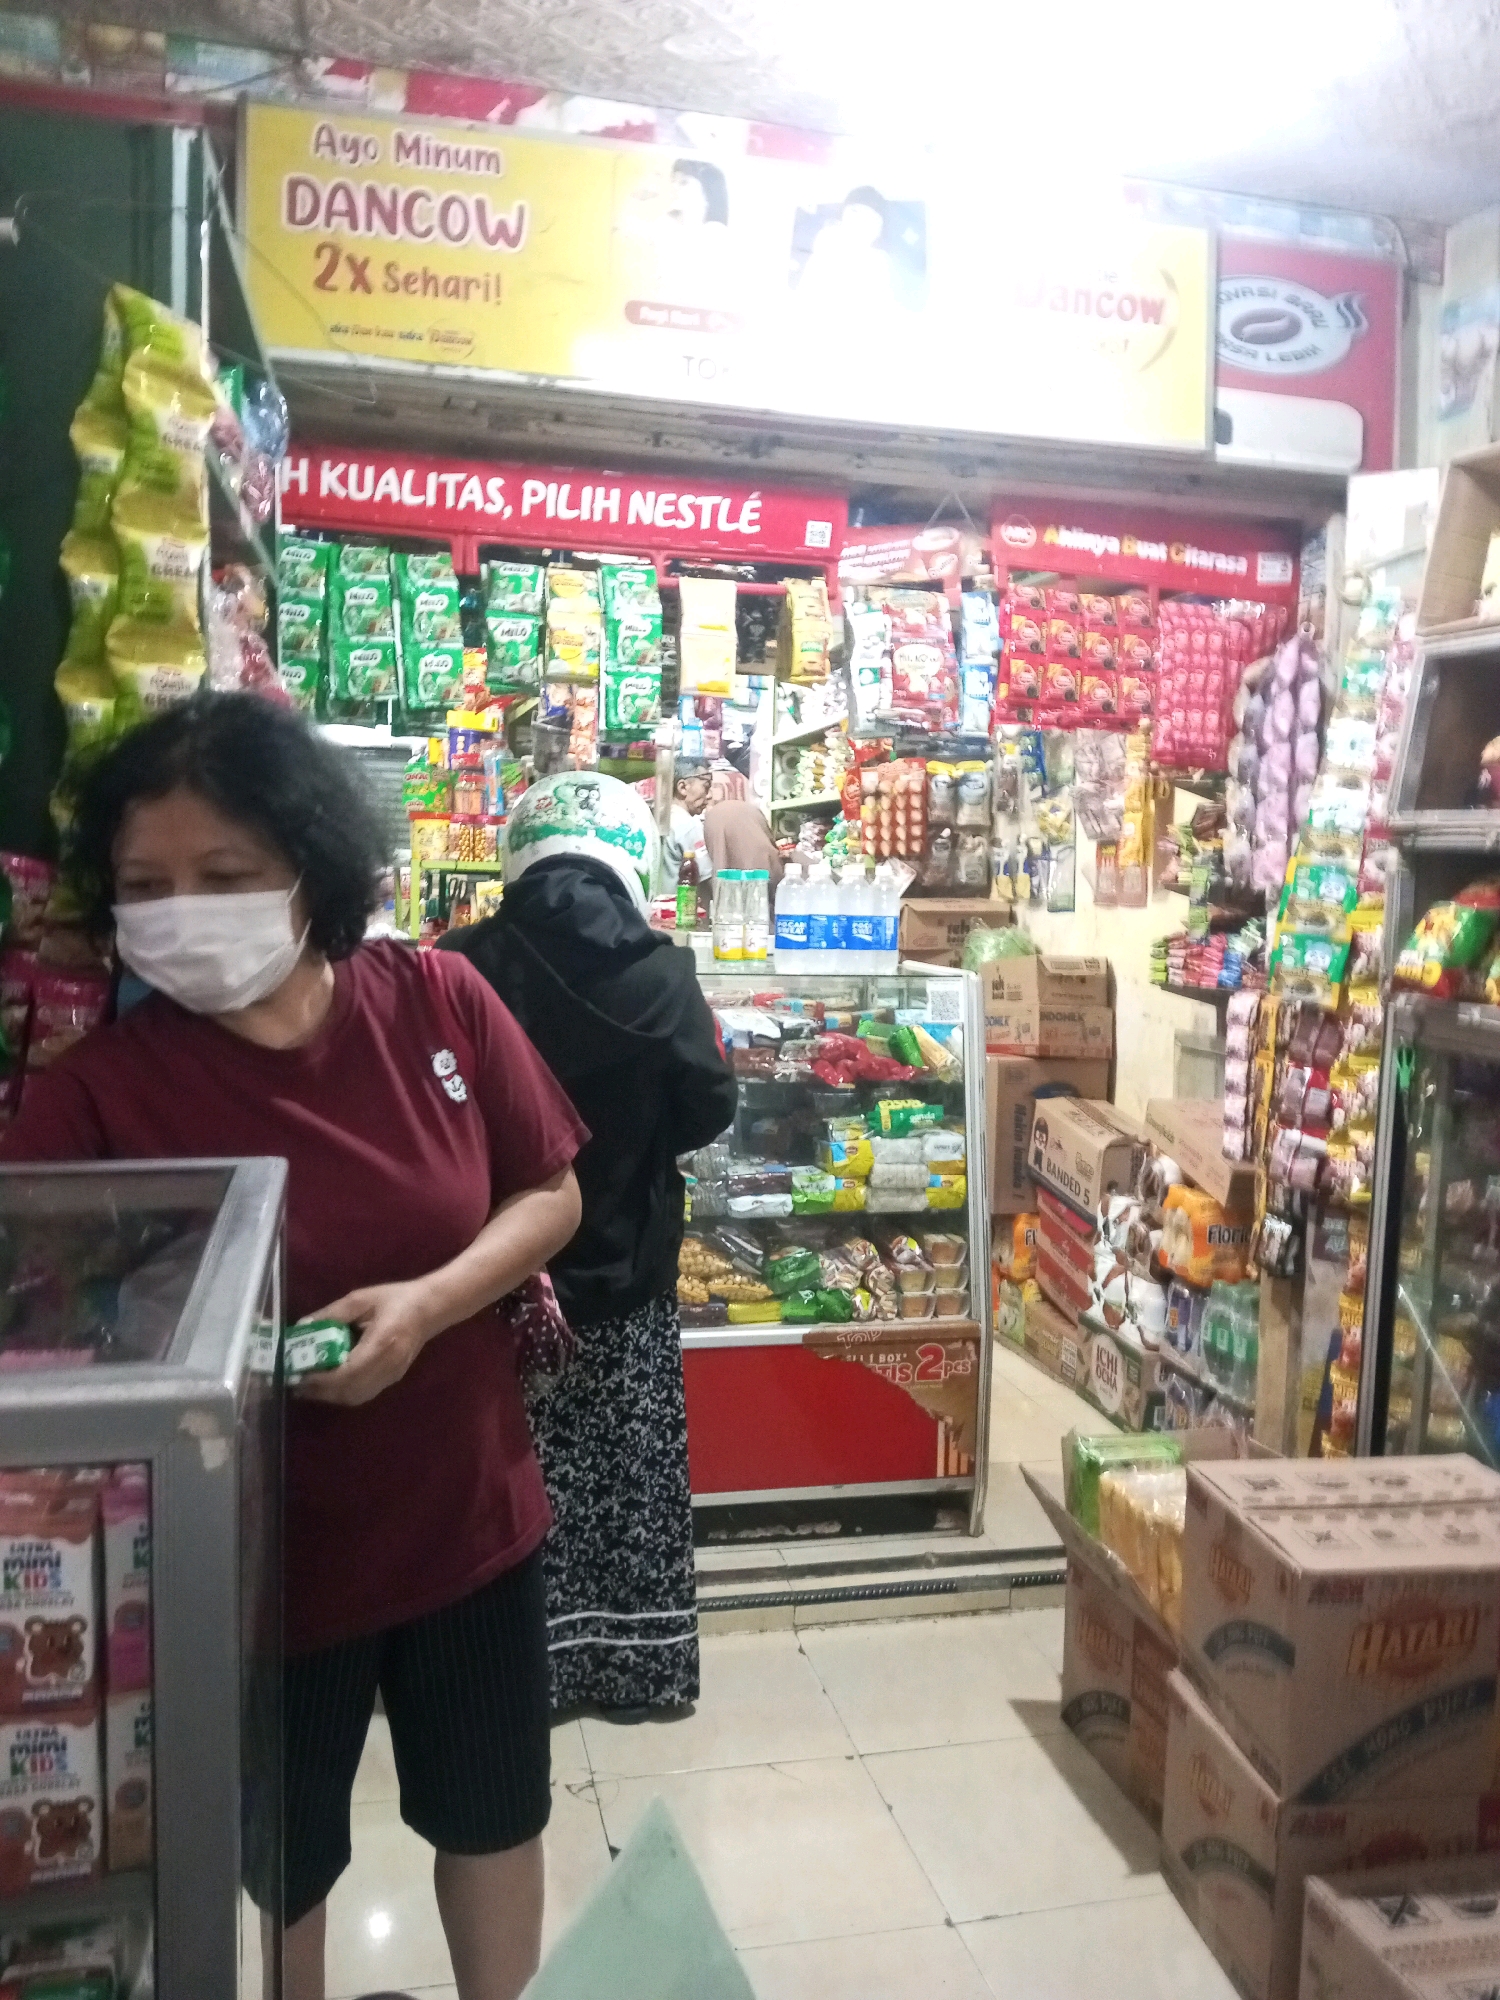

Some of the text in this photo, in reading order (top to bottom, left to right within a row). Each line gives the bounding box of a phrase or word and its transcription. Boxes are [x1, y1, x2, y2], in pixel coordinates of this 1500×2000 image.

[314, 123, 501, 174] Ayo Minum
[286, 177, 525, 248] DANCOW
[383, 261, 502, 305] Sehari!
[319, 459, 514, 521] KUALITAS,
[521, 479, 621, 523] PILIH
[627, 491, 763, 534] NESTLÉ
[1121, 533, 1168, 562] Buat
[1170, 540, 1248, 577] Citarasa
[1046, 1157, 1081, 1198] BANDED
[1083, 1188, 1090, 1206] 5
[915, 1343, 946, 1381] 2
[1096, 1345, 1118, 1375] ICHI
[3, 1551, 62, 1571] mimi
[3, 1568, 62, 1590] KIDS
